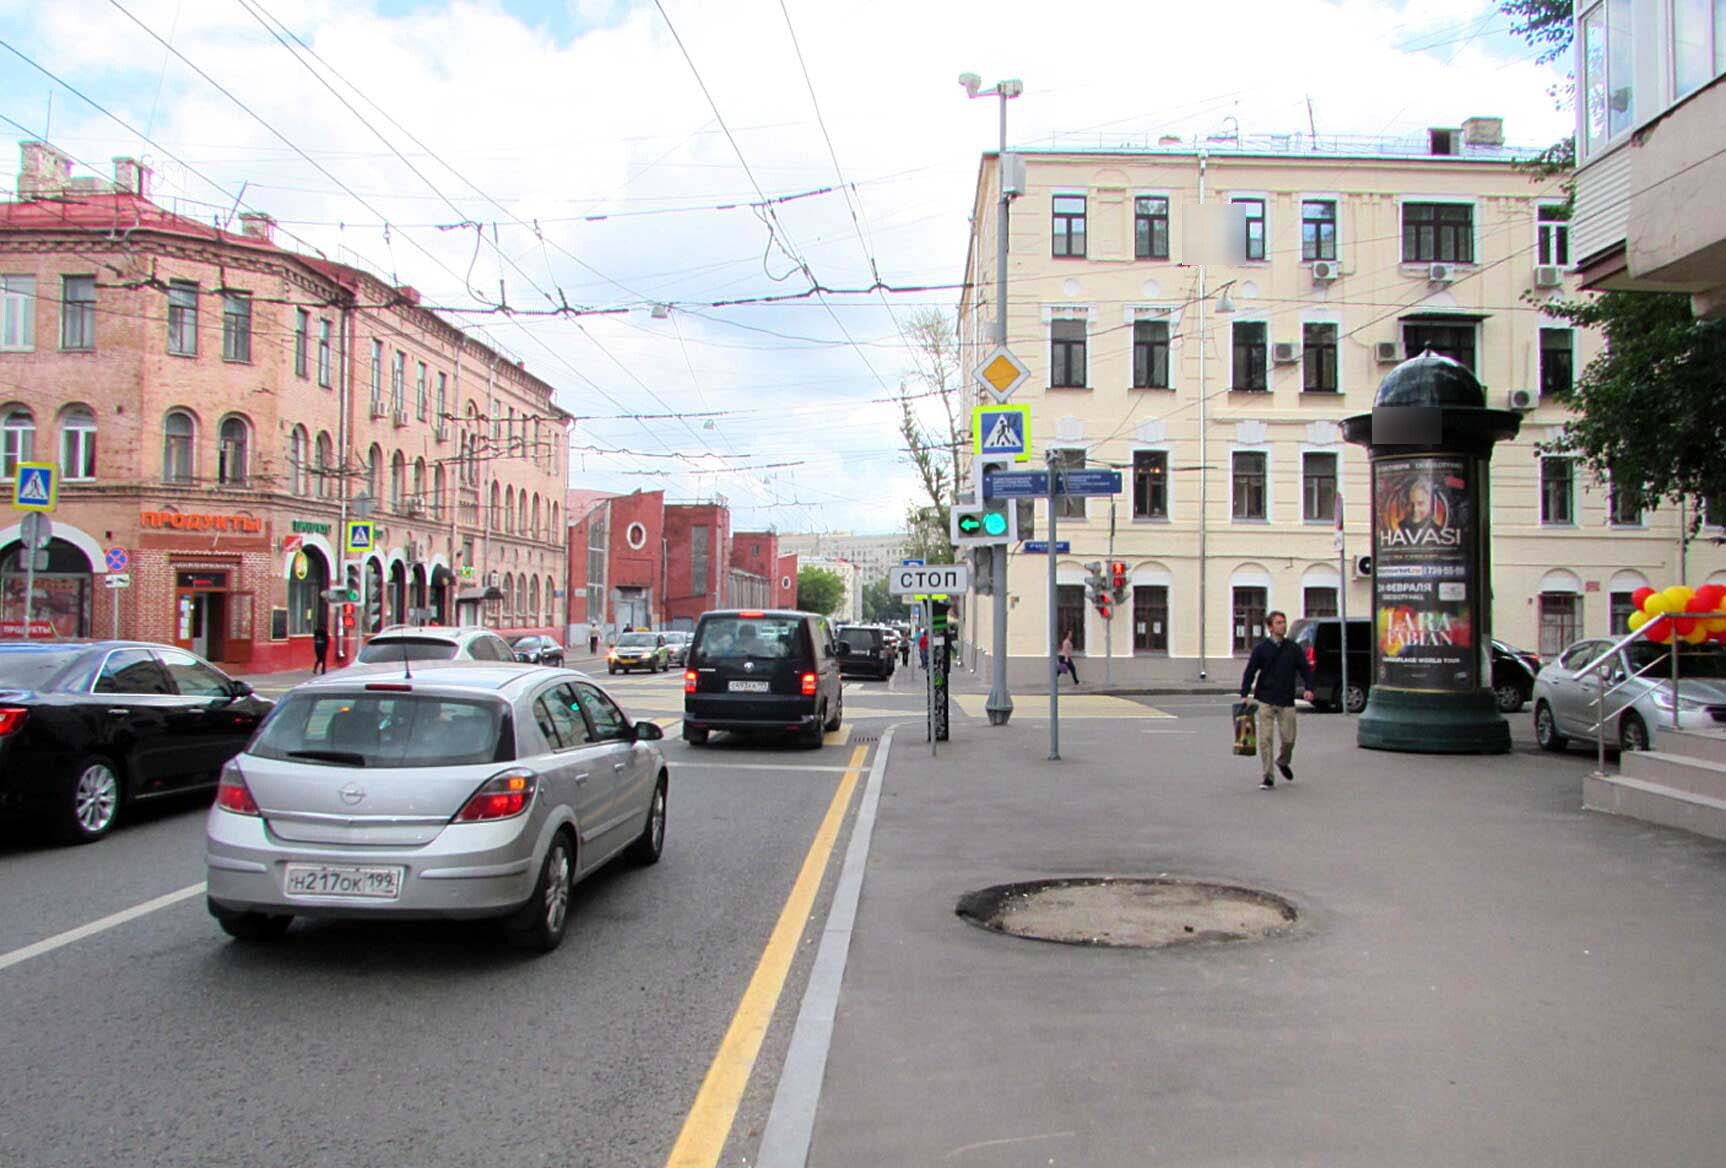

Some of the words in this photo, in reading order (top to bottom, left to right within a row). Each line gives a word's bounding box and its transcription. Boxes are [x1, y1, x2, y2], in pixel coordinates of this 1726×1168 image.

[141, 511, 262, 532] ПРОДУКТЫ
[1380, 528, 1461, 546] HAVASI
[901, 572, 957, 588] СТОП
[1387, 582, 1432, 592] ФЕВРАЛЯ
[1388, 612, 1453, 631] LARA
[4, 626, 50, 634] ПРОДКТЫ
[1388, 631, 1453, 646] FABIAN
[367, 873, 394, 888] 199
